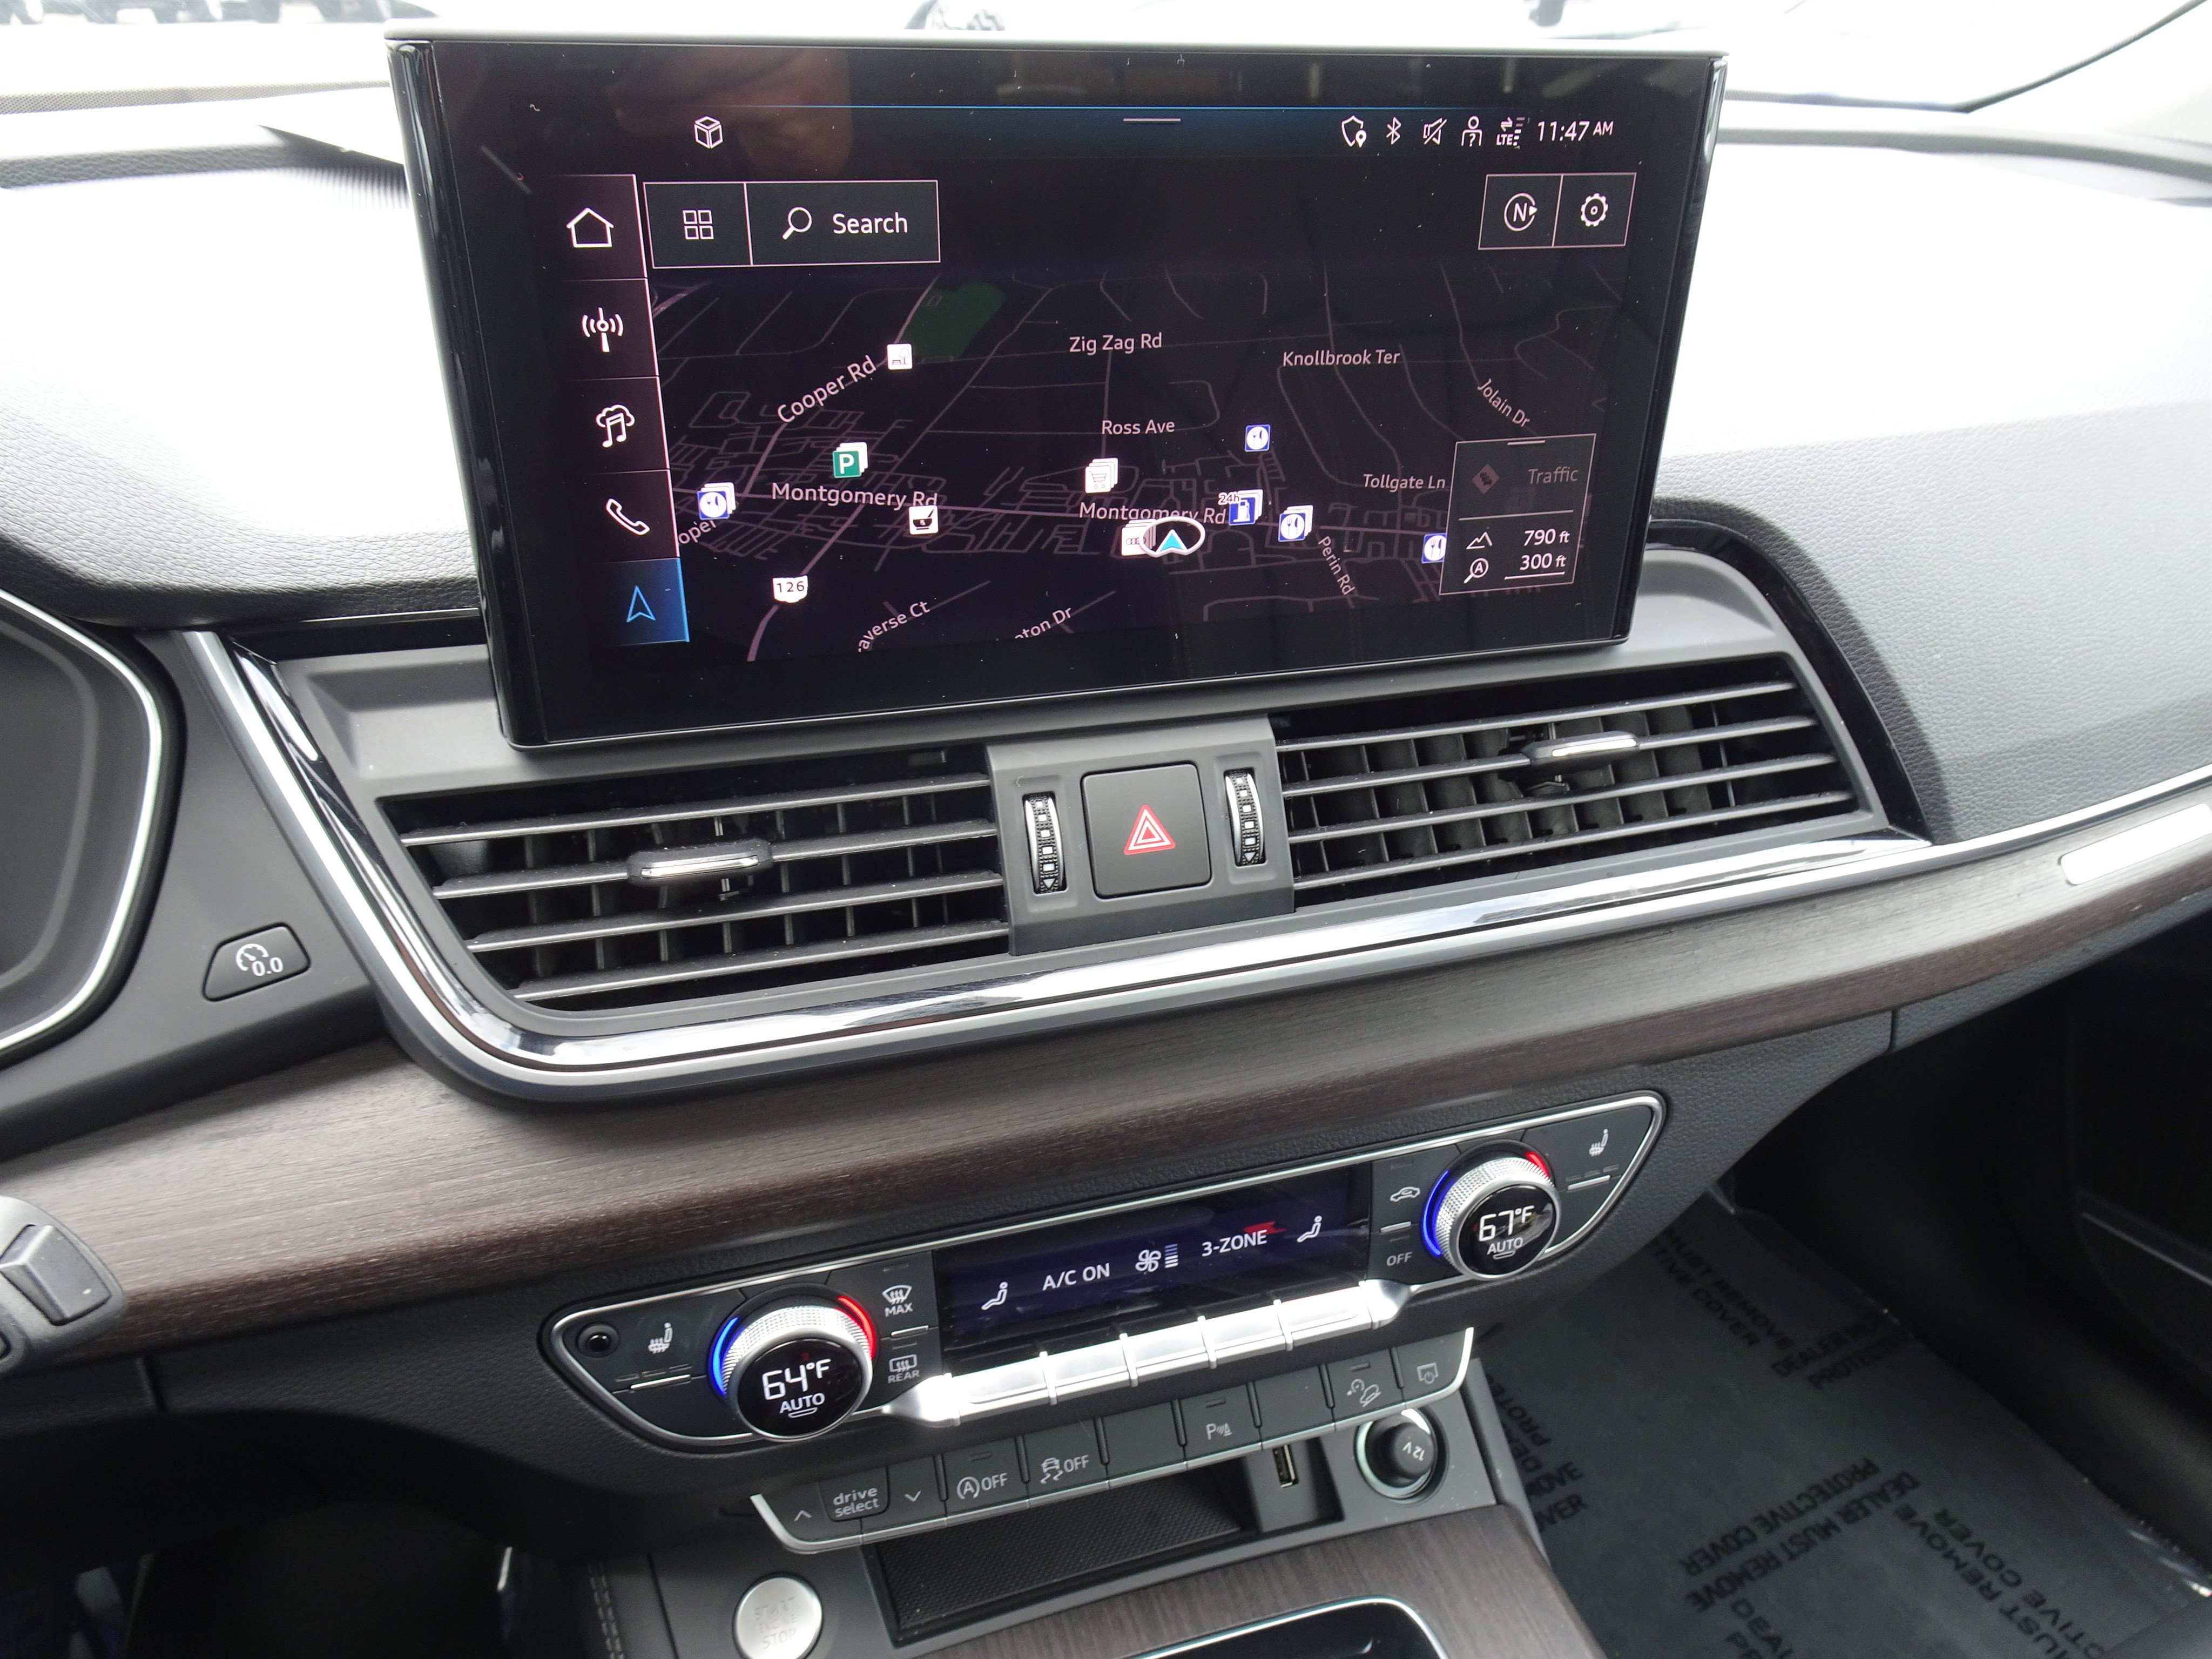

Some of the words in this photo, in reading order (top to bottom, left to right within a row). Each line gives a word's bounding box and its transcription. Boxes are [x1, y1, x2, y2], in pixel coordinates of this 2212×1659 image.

[1537, 121, 1590, 142] 11:47
[1593, 121, 1614, 136] AM
[832, 211, 908, 234] Search
[1069, 337, 1097, 355] Zig
[1102, 335, 1135, 353] Zag
[1141, 332, 1163, 349] Rd
[1283, 349, 1372, 367] Knollbrook
[1375, 350, 1400, 365] Ter
[777, 375, 845, 423] Cooper
[846, 354, 877, 383] Rd
[1476, 378, 1512, 417] Jolain
[1512, 409, 1530, 427] Dr
[1101, 420, 1141, 435] Ross
[1145, 419, 1175, 434] Ave
[1363, 473, 1424, 493] Tollgate
[1428, 476, 1446, 490] Ln
[1527, 466, 1579, 484] Traffic
[771, 482, 906, 511] Montgomery
[913, 490, 938, 507] Rd
[1203, 507, 1226, 524] Rd
[1523, 529, 1556, 545] 790
[1559, 531, 1570, 544] ft
[1318, 536, 1341, 575] Perin
[1337, 574, 1355, 595] Rd
[1519, 554, 1553, 570] 300
[1555, 554, 1566, 568] ft
[776, 581, 805, 594] 126
[857, 613, 908, 653] averse
[909, 601, 930, 618] Ct
[1052, 608, 1071, 624] Dr
[251, 956, 284, 977] 0.0
[1201, 1229, 1267, 1257] 3-ZONE
[1486, 1237, 1523, 1256] AUTO
[1385, 1251, 1413, 1267] OFF
[1042, 1269, 1077, 1292] A/C
[1082, 1263, 1111, 1282] ON
[884, 1302, 914, 1317] MAX
[1691, 1286, 1761, 1346] COVER
[887, 1369, 920, 1385] REAR
[779, 1393, 825, 1414] AUTO
[1063, 1454, 1090, 1473] OFF
[980, 1472, 1008, 1492] OFF
[833, 1485, 878, 1507] drive
[834, 1496, 880, 1518] select
[1751, 1456, 1881, 1536] PROTECTIVE
[1834, 1470, 1921, 1526] DEALER
[1779, 1515, 1842, 1563] MUST
[1933, 1507, 2024, 1588] COVER
[1677, 1524, 1759, 1577] COVER
[1892, 1502, 2004, 1602] REMOVE
[1684, 1547, 1784, 1613] REMOVE
